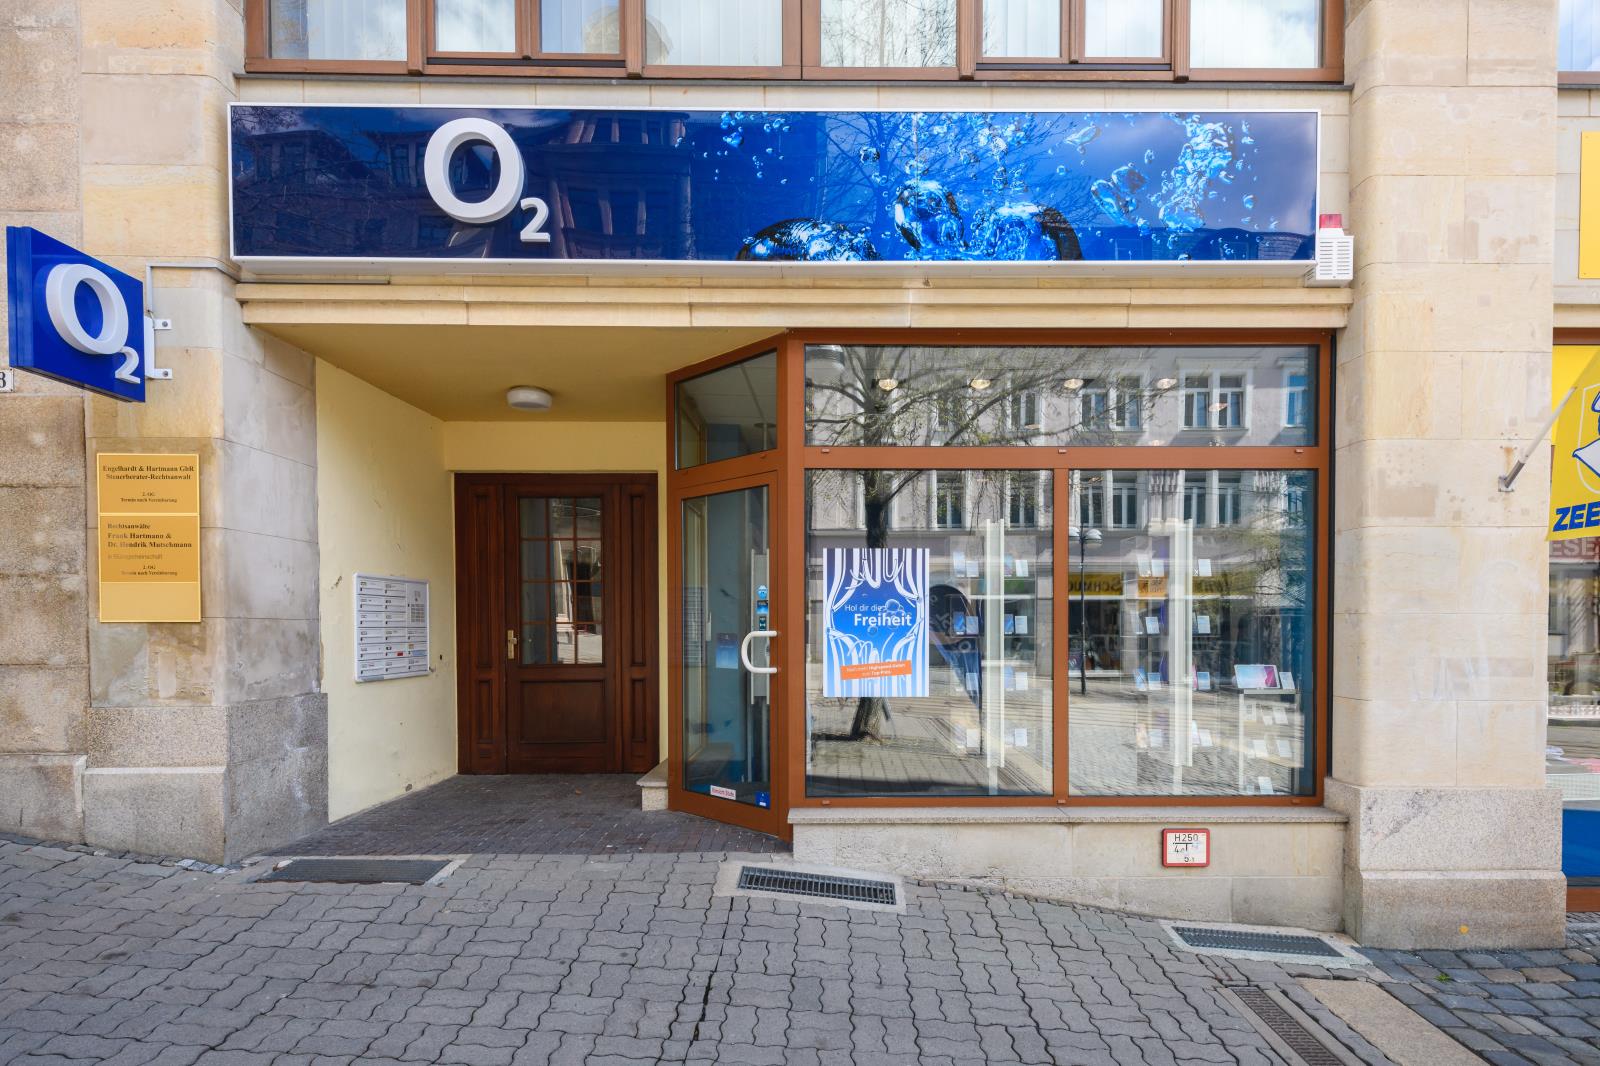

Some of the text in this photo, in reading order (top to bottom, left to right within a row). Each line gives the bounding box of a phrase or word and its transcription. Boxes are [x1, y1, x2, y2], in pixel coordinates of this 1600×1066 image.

[424, 117, 550, 242] O2
[46, 263, 141, 384] O2
[854, 614, 912, 626] Freiheit
[1174, 834, 1198, 842] H250
